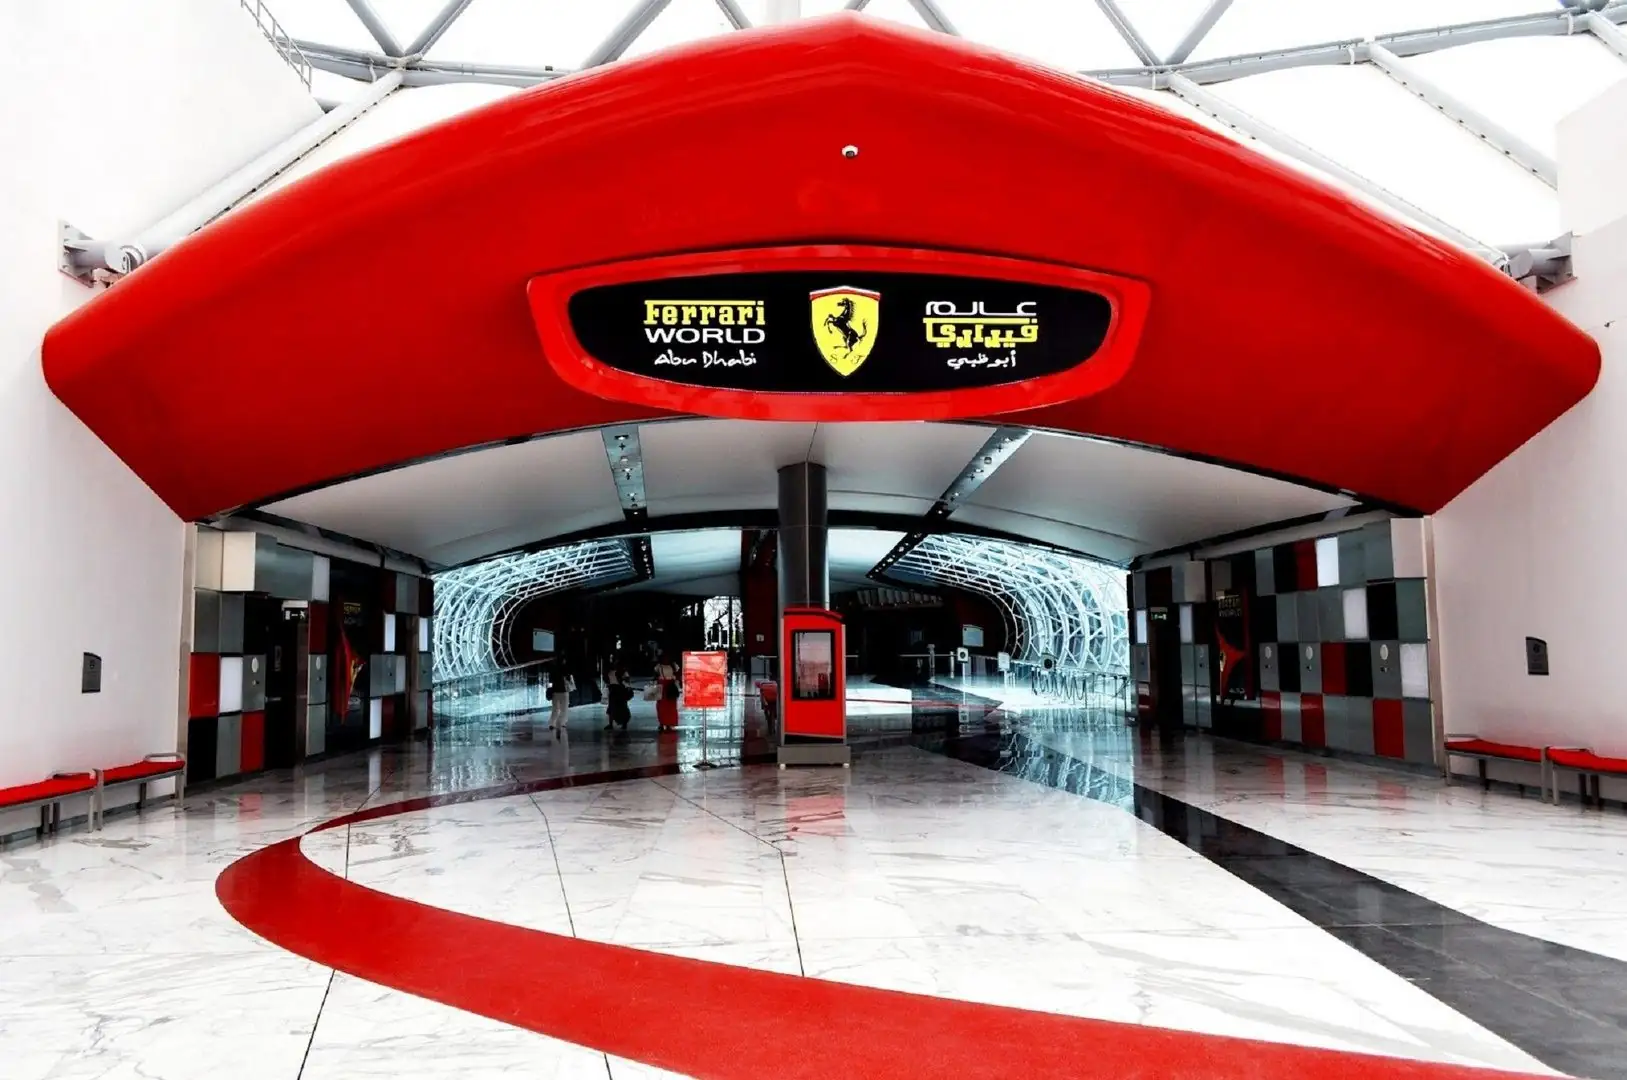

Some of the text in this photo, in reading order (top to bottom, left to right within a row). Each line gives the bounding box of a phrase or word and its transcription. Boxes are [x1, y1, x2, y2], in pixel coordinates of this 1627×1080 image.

[643, 300, 766, 325] Ferrari
[926, 301, 1037, 316] عالم
[644, 328, 766, 344] WORLD
[923, 318, 1039, 348] فيراري
[654, 349, 757, 368] Abu Dhabi
